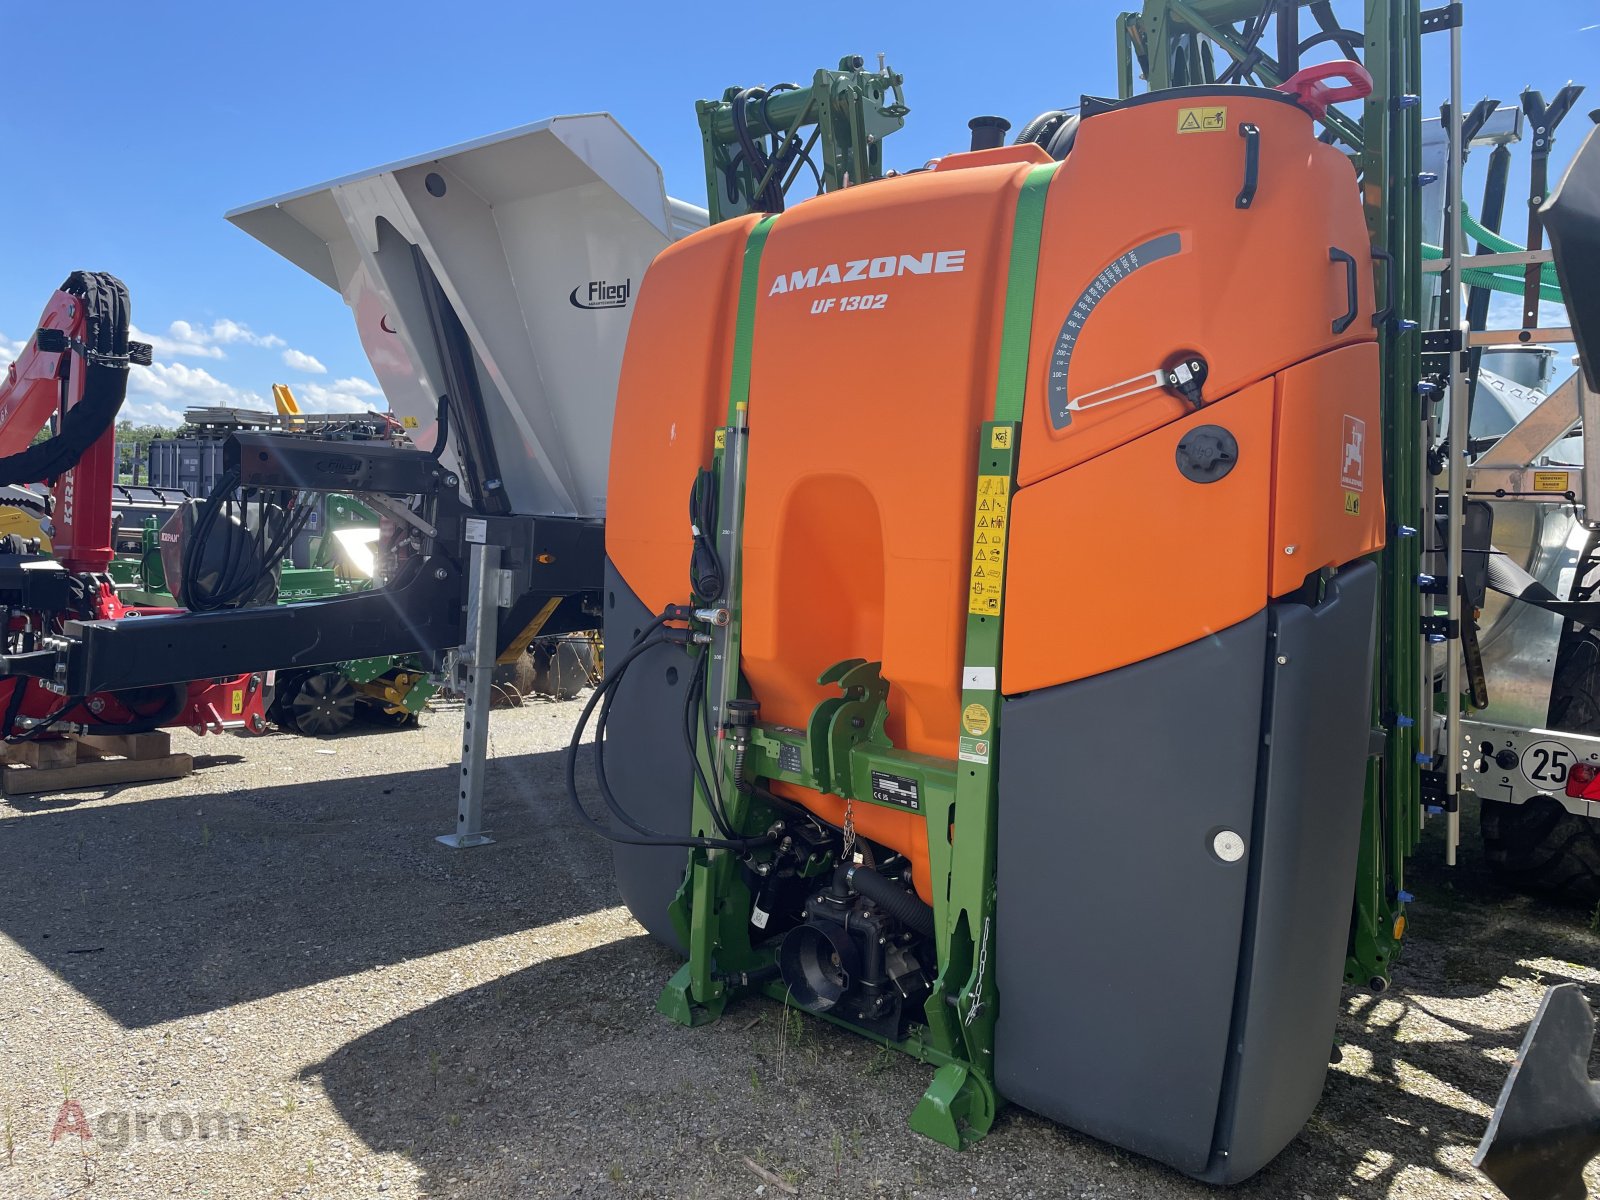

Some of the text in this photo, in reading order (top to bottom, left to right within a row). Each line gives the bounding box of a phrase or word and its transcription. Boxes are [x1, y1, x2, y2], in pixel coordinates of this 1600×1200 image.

[769, 250, 966, 297] AMAZONE
[588, 278, 630, 303] Fliegl
[810, 294, 888, 315] UF 1302
[1531, 748, 1569, 783] 25
